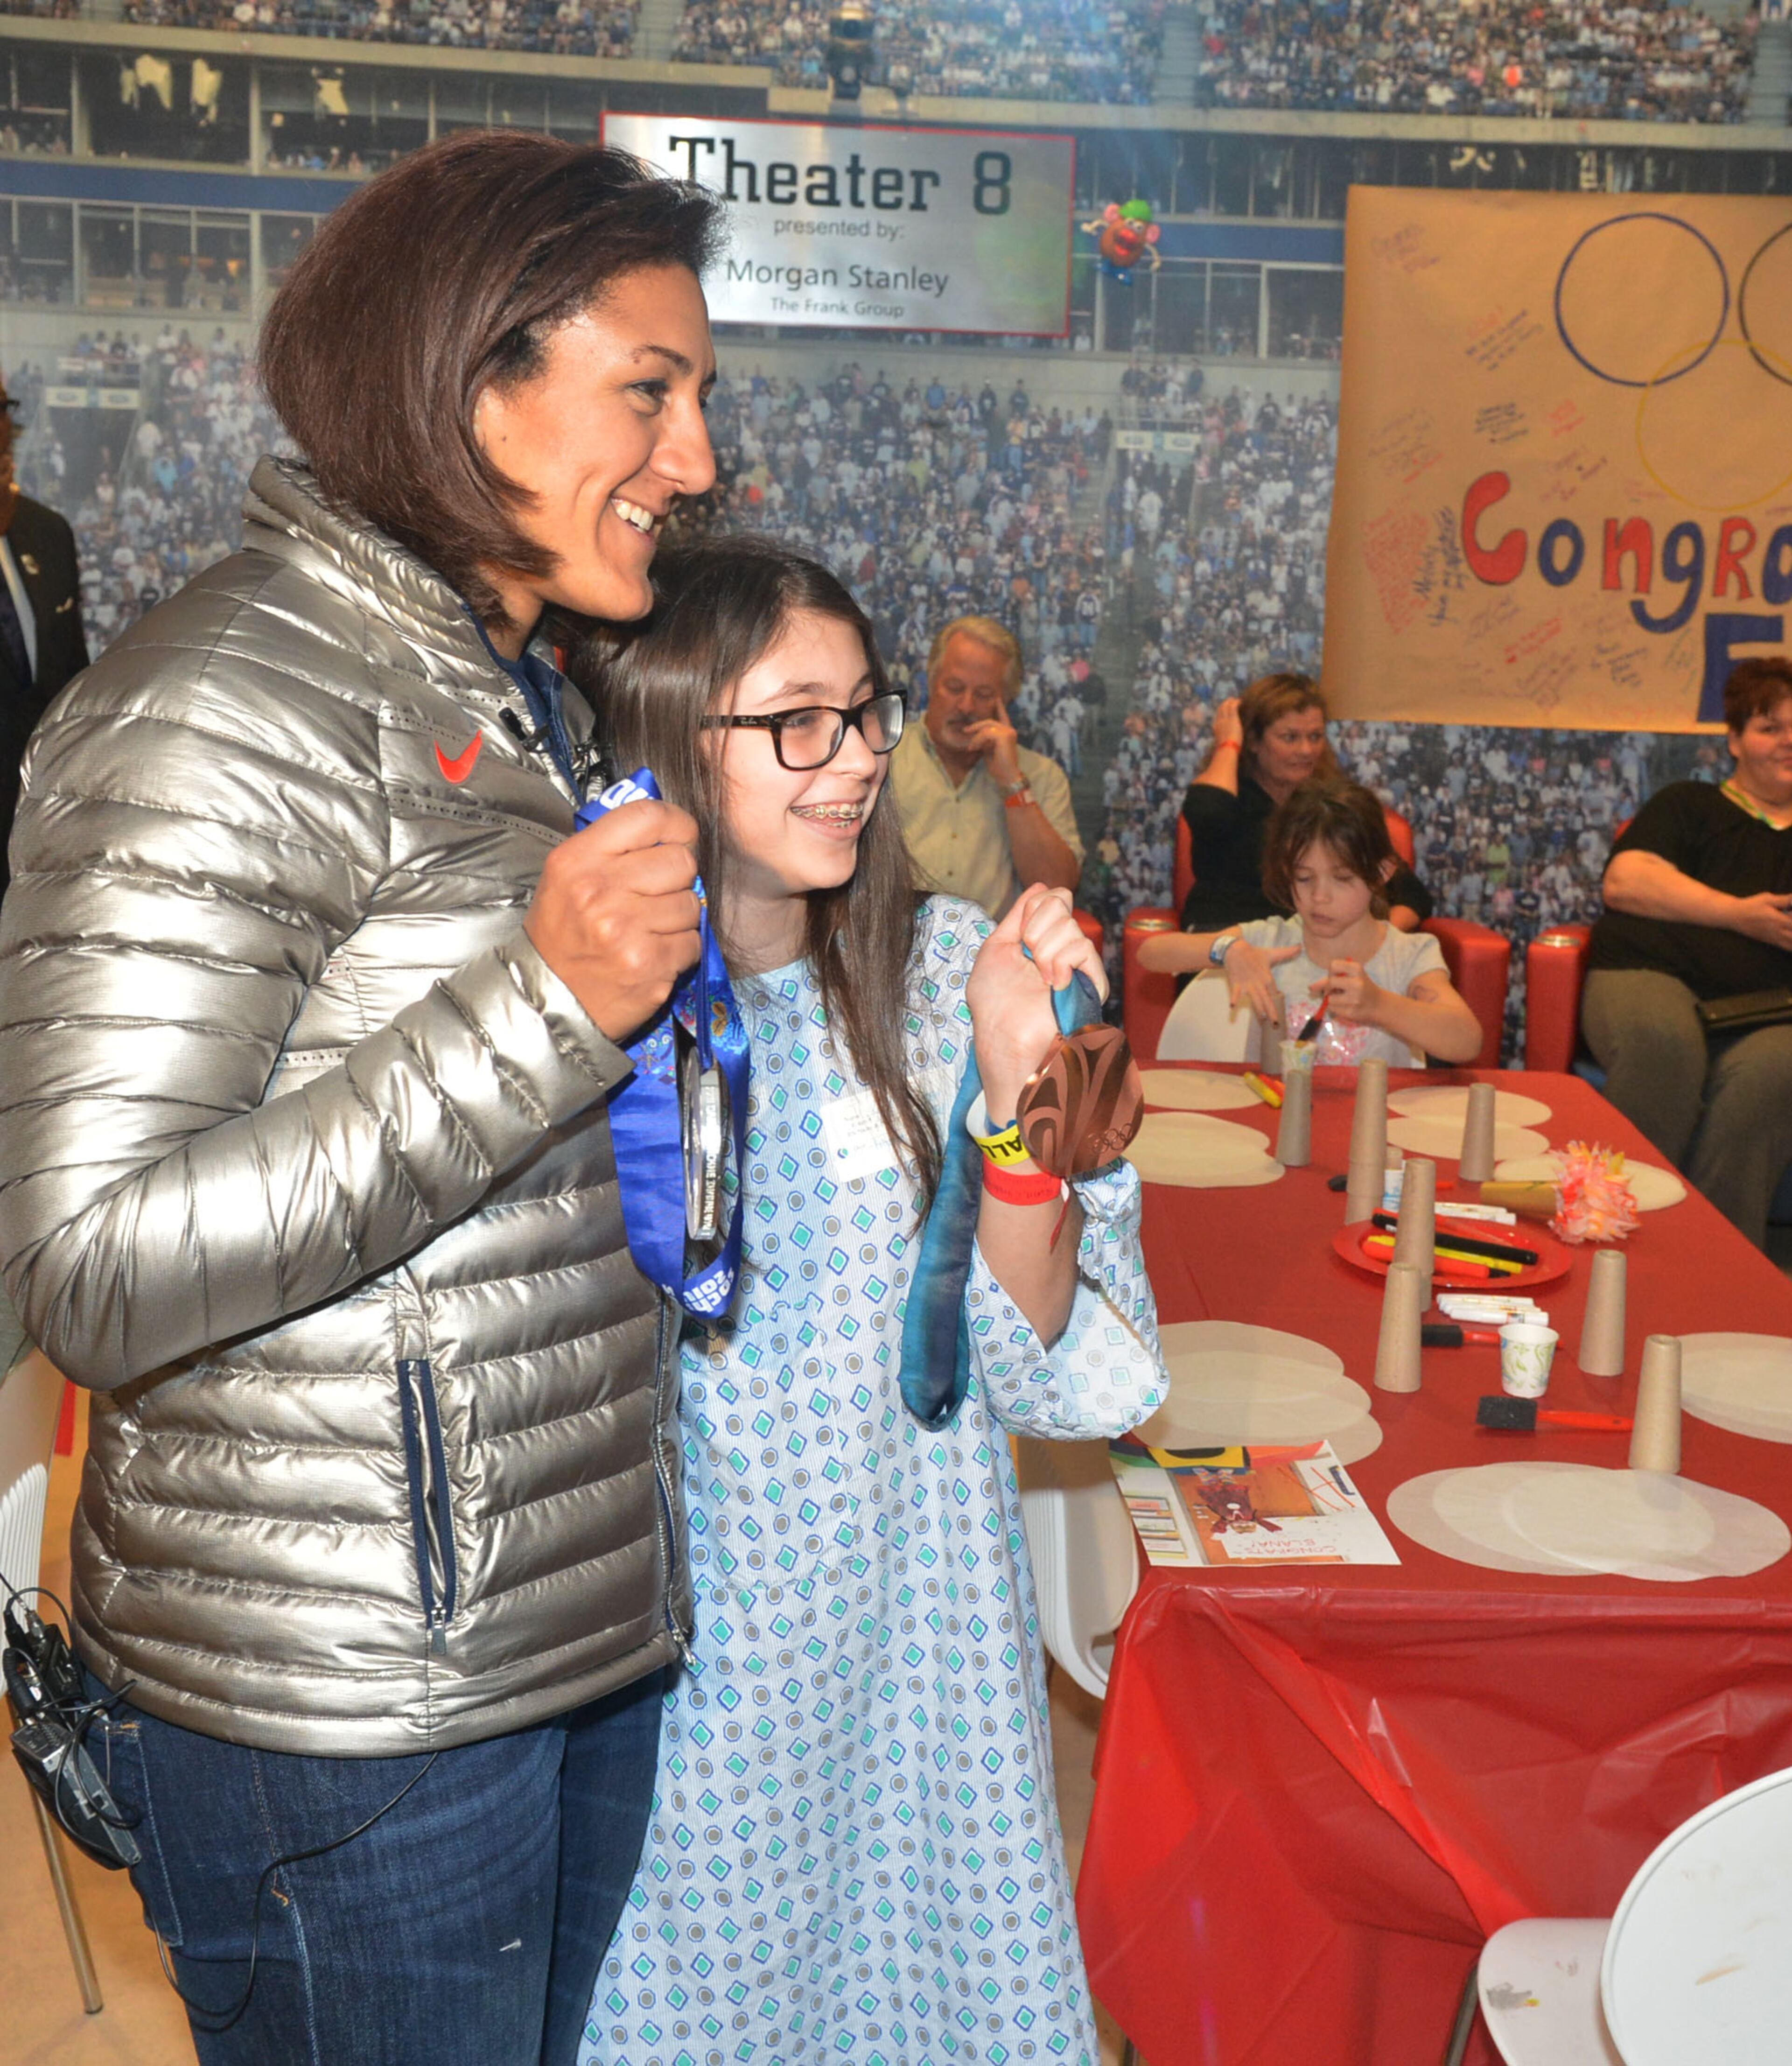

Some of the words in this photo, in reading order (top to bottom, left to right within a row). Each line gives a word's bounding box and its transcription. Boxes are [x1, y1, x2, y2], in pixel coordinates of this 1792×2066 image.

[669, 135, 940, 212] Theater
[972, 150, 1012, 215] 8
[774, 217, 870, 238] presented
[876, 220, 905, 242] by:
[727, 259, 839, 291] Morgan
[848, 263, 950, 298] Stanley
[771, 297, 799, 312] The
[805, 299, 848, 315] Frank
[854, 301, 905, 319] Group
